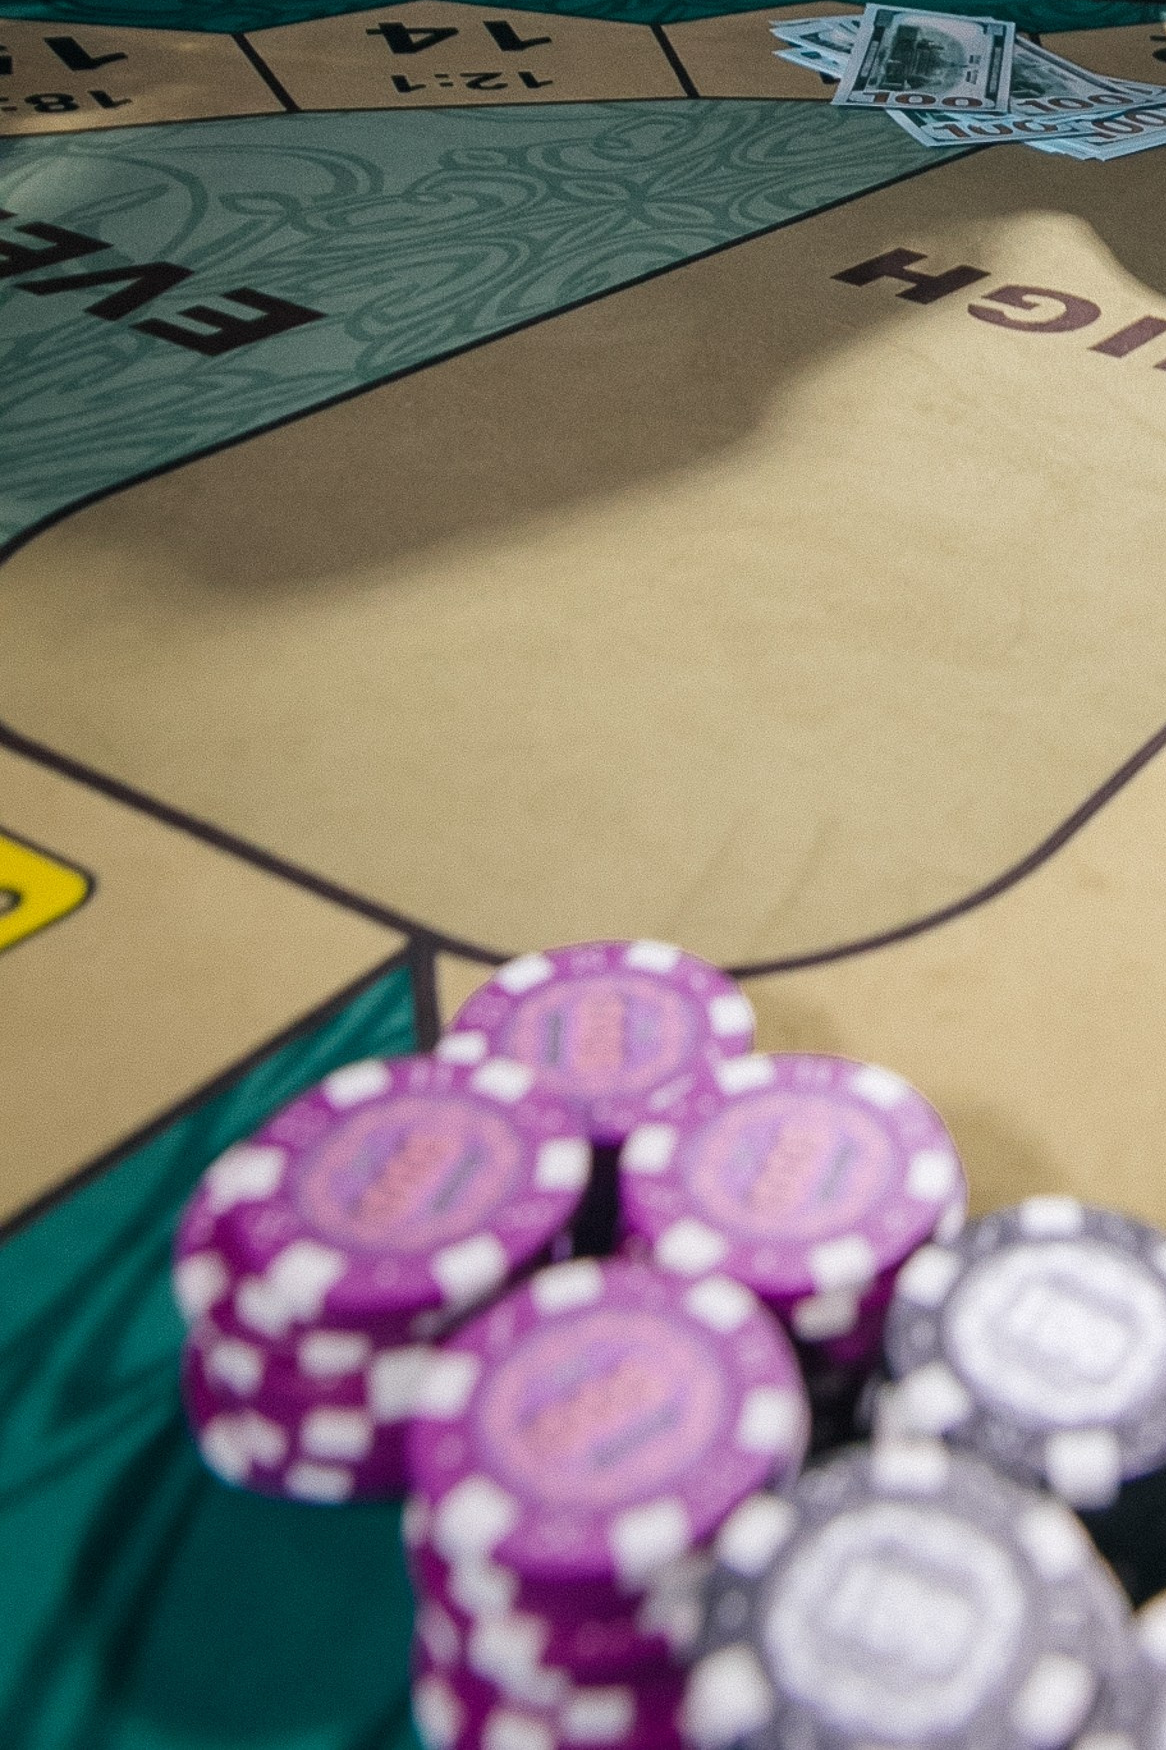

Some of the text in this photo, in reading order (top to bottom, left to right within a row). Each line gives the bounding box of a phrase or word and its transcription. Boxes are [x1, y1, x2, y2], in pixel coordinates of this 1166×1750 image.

[364, 20, 552, 54] 14
[0, 36, 128, 75] 1
[389, 70, 554, 95] 12:1
[862, 91, 983, 108] 100
[1016, 93, 1134, 112] 100
[0, 210, 328, 357] EVE
